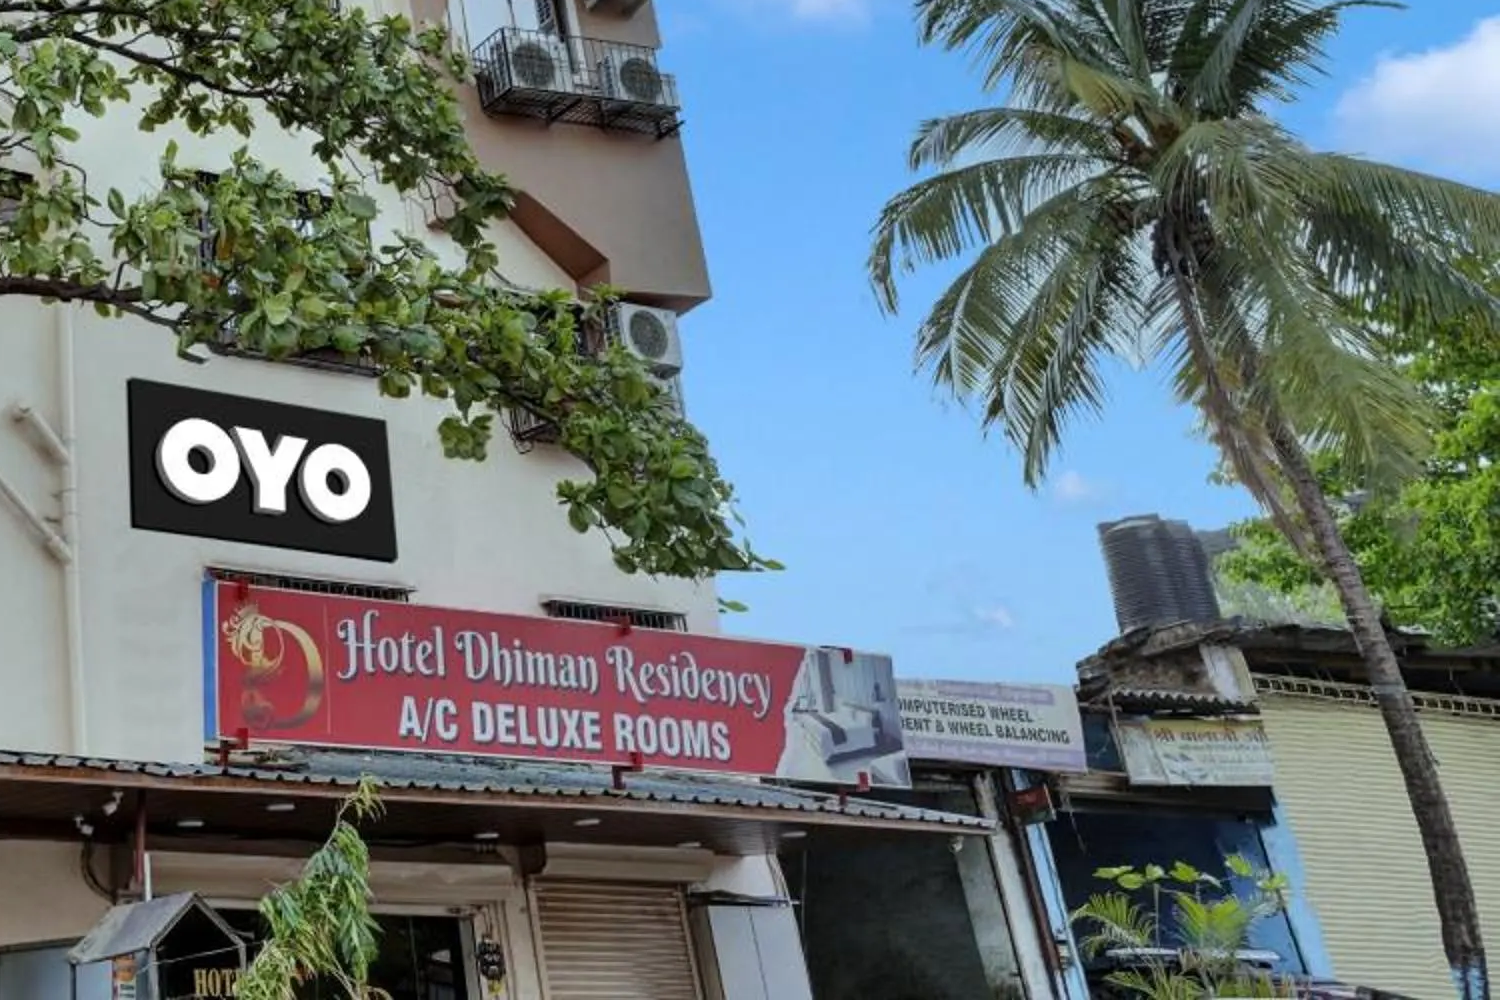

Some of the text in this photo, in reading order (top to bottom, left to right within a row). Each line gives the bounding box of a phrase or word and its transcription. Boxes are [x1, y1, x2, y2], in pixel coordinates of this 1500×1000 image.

[155, 417, 372, 525] OYO
[337, 609, 771, 720] Hotel Dhiman Residency
[398, 695, 732, 761] A/C DELUXE ROOMS
[948, 721, 993, 737] WHEEL
[995, 724, 1071, 744] BALANCING
[989, 706, 1034, 723] WHEEL
[193, 967, 244, 998] HOT
